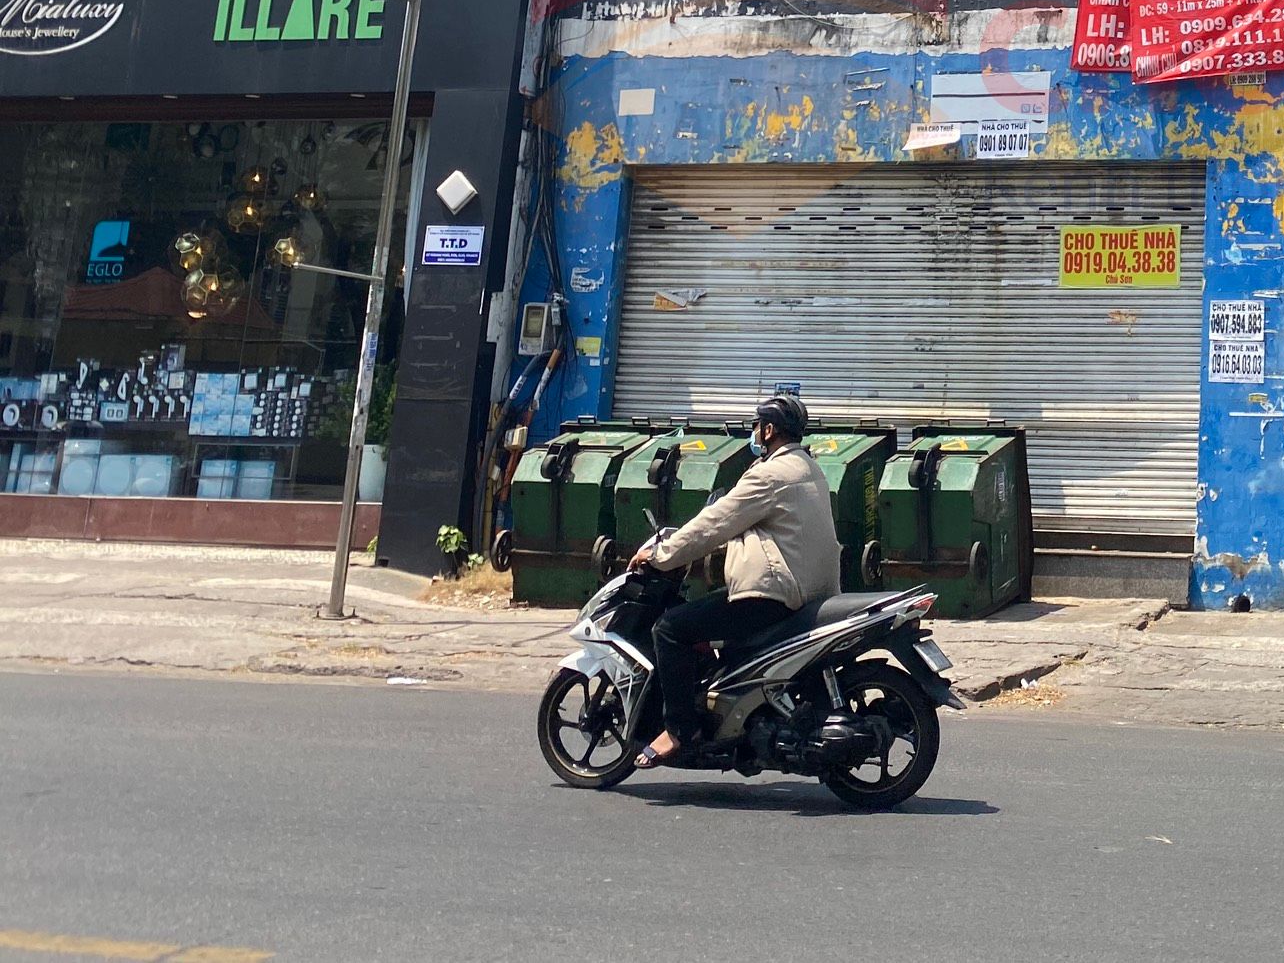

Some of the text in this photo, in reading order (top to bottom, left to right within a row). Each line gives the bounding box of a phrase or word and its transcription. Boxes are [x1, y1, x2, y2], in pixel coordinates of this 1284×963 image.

[1157, 2, 1168, 15] 59
[1177, 0, 1195, 13] 11m
[32, 25, 80, 39] Jewellery
[1087, 14, 1125, 38] LH:
[1141, 26, 1170, 46] LH:
[982, 122, 1027, 131] NHÀ CHO THUÊ
[979, 134, 1028, 152] 0901 89 07 07
[439, 238, 468, 249] T.T.D
[1064, 227, 1176, 250] CHO THUÊ NHÀ
[1064, 250, 1176, 274] 0919.04.38.38
[87, 263, 123, 277] EGLO
[1212, 303, 1226, 312] CHO
[1228, 302, 1246, 312] THUÊ
[1213, 344, 1226, 352] CHO
[1228, 344, 1244, 352] THUÊ
